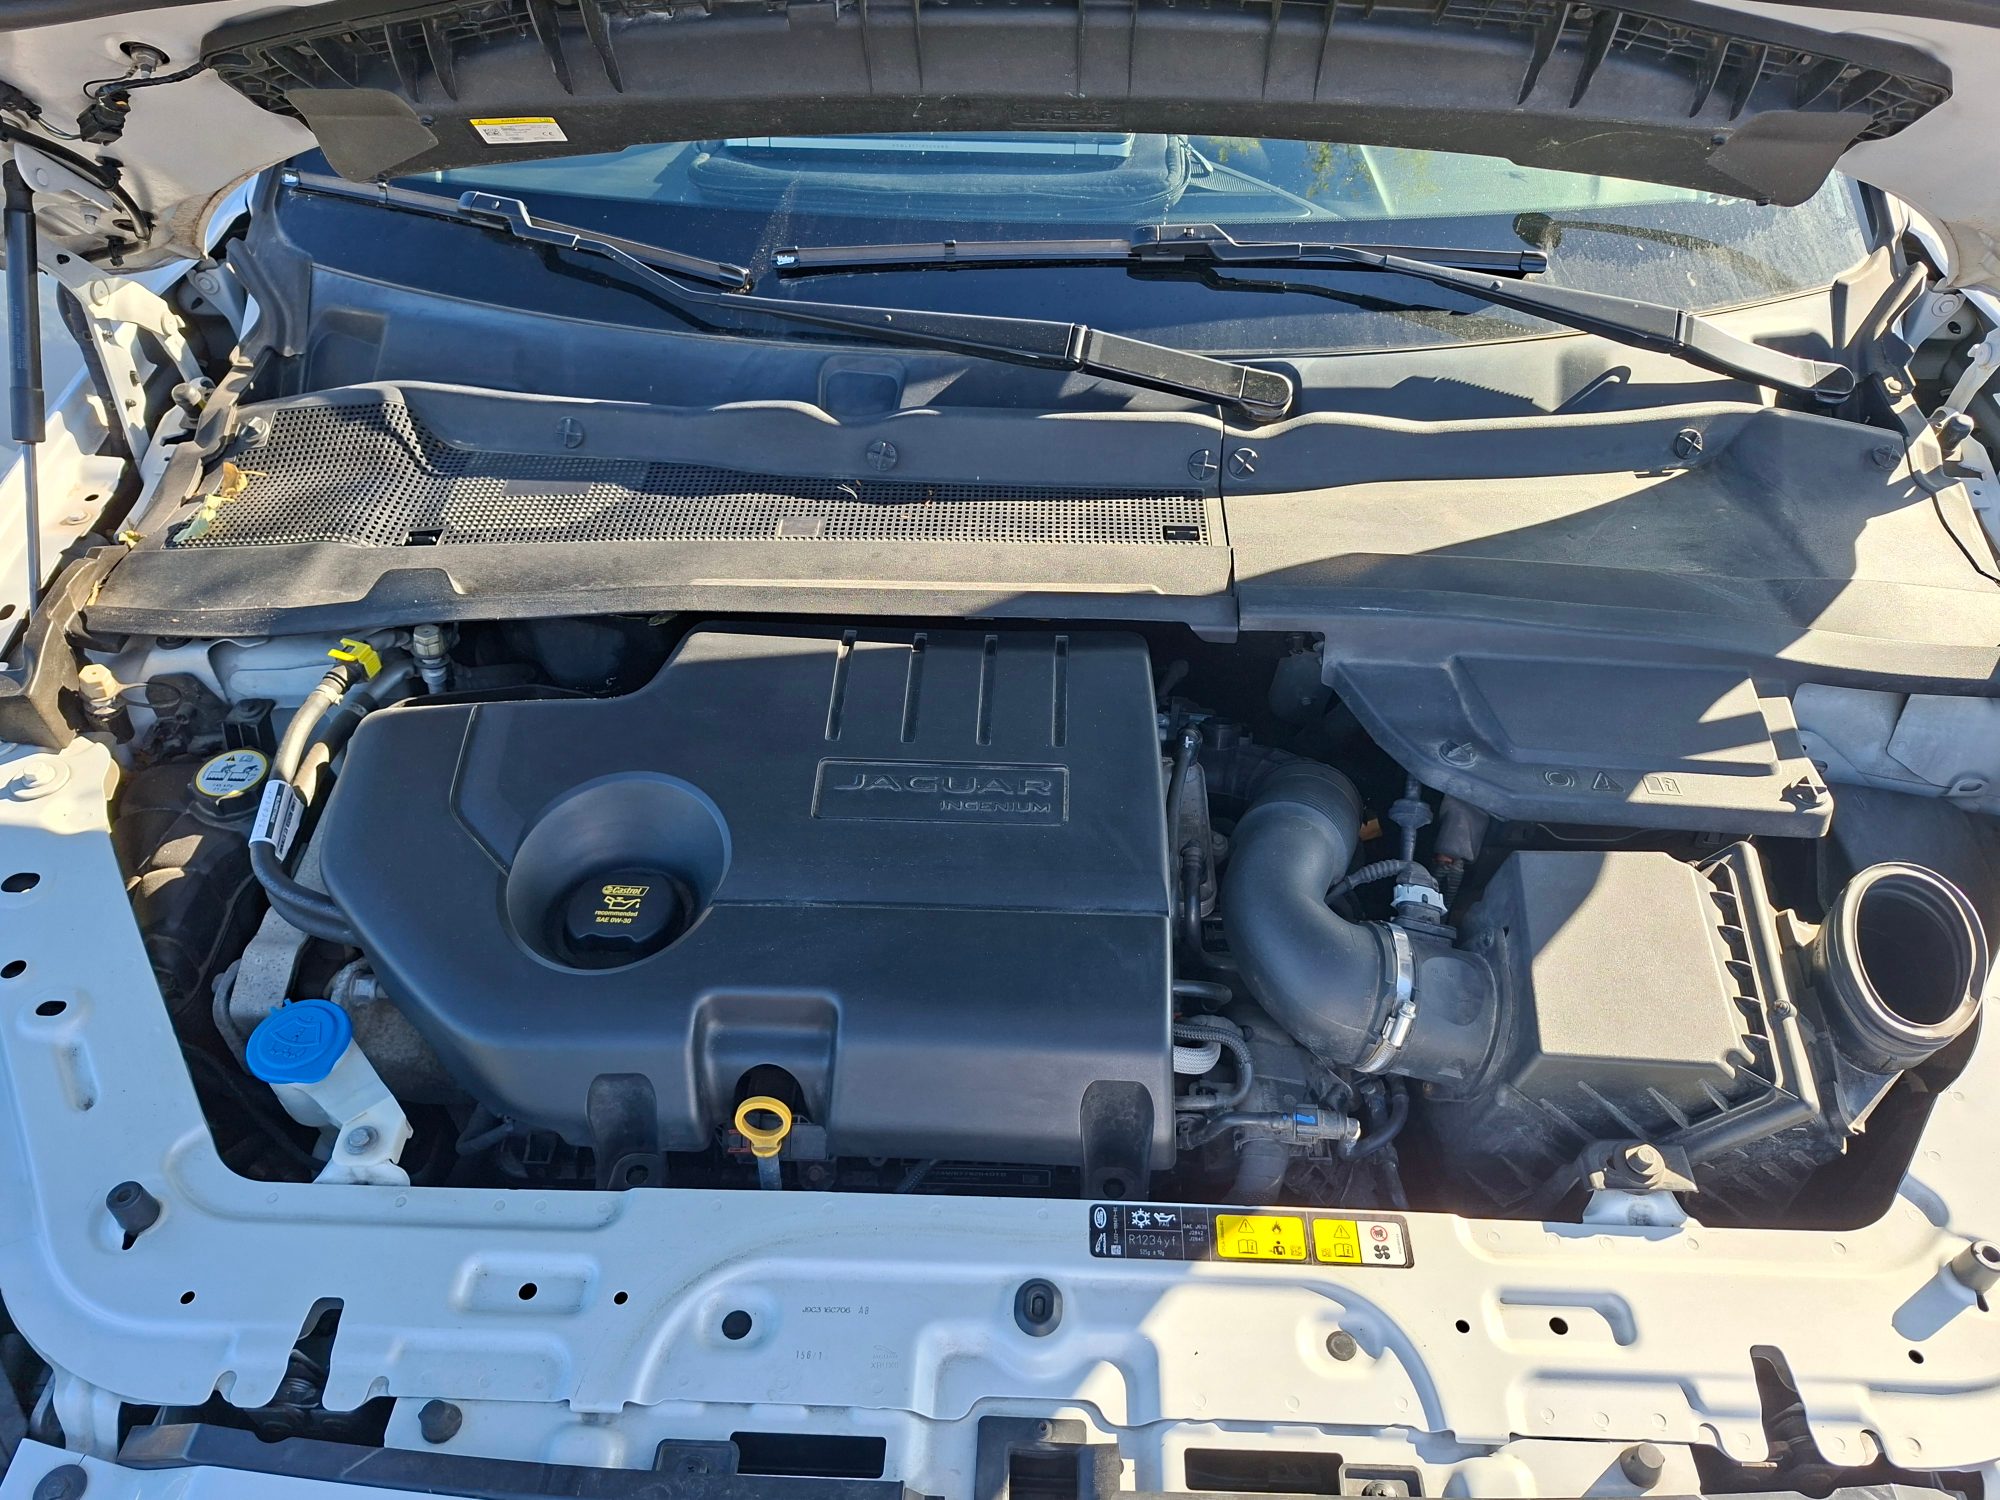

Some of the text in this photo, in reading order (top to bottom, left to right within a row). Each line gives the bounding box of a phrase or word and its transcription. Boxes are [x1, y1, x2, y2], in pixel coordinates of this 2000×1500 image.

[834, 773, 1052, 796] JAGUAR
[940, 800, 1050, 813] INGENIUM
[612, 886, 642, 895] Castrol
[1129, 1234, 1176, 1248] R1234yf
